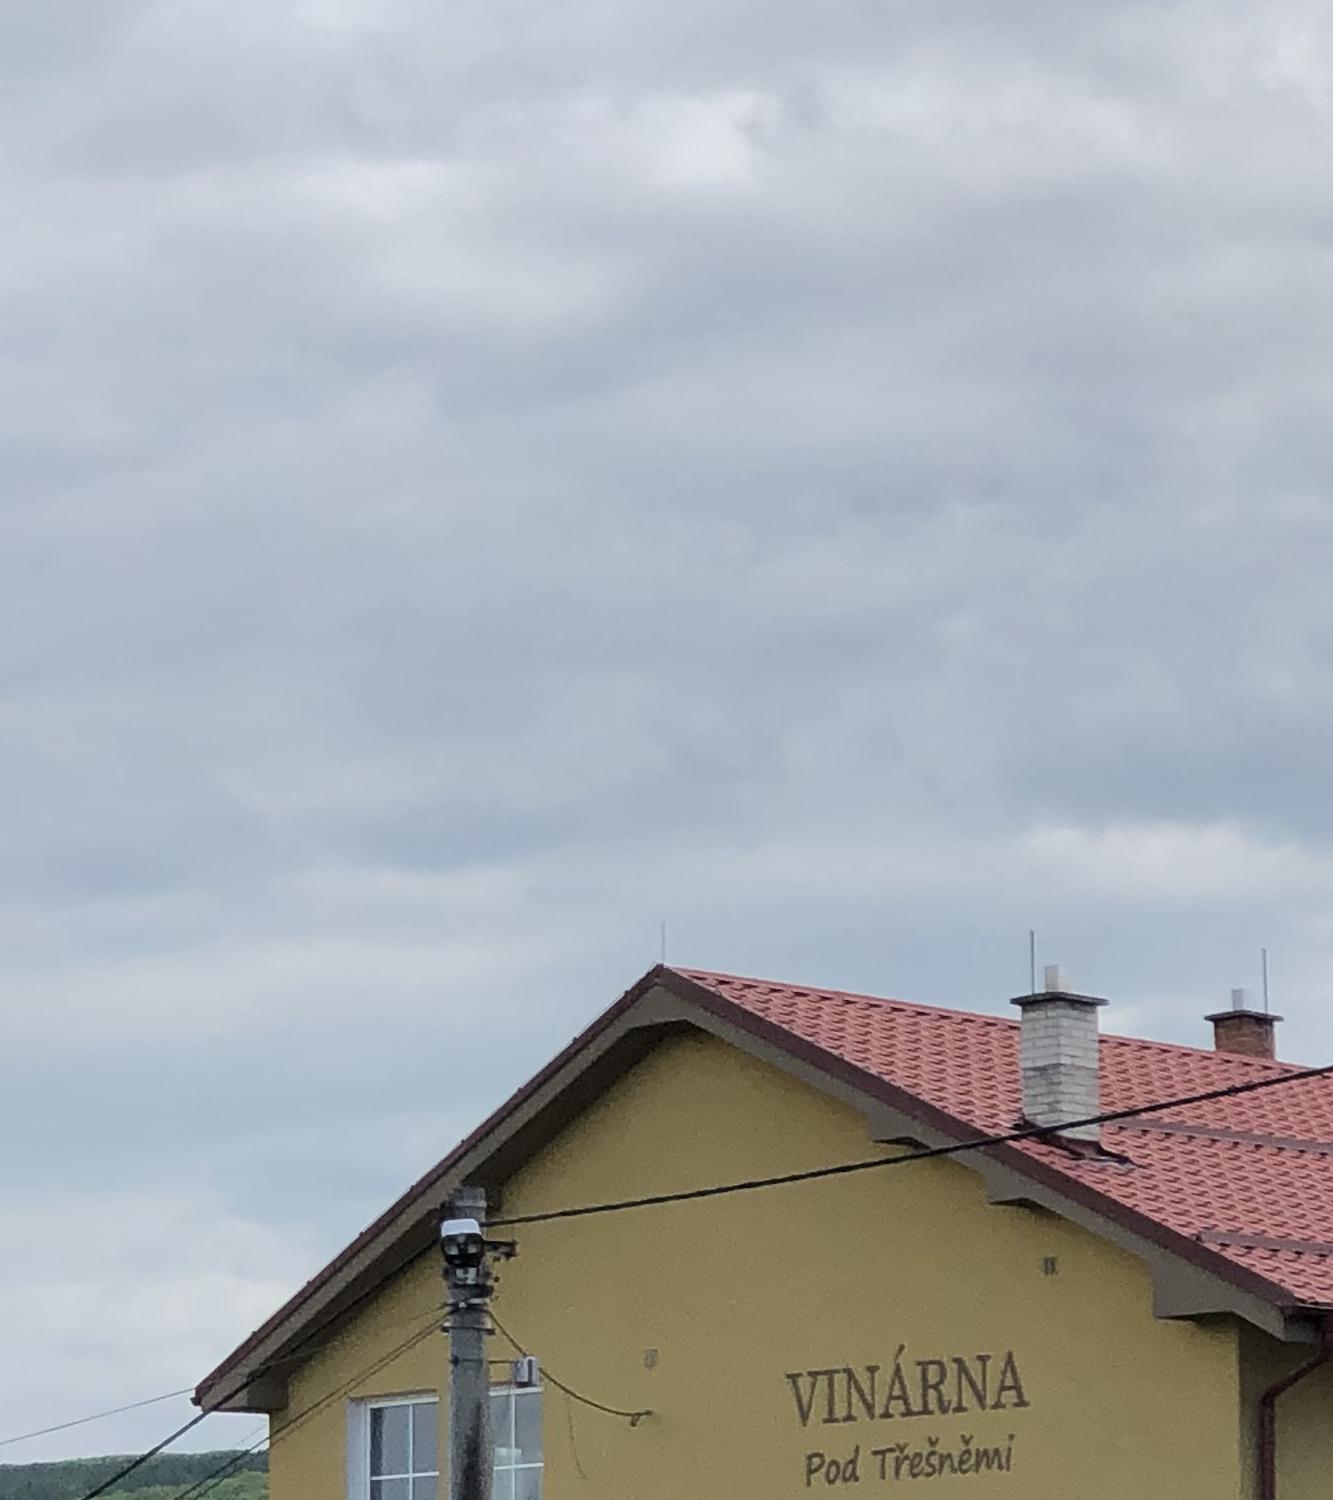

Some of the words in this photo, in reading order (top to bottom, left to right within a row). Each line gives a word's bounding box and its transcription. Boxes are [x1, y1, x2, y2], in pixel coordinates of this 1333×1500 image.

[785, 1344, 1030, 1427] VINÁRNA
[806, 1445, 860, 1488] Pod
[872, 1433, 1016, 1481] Třešněmi
